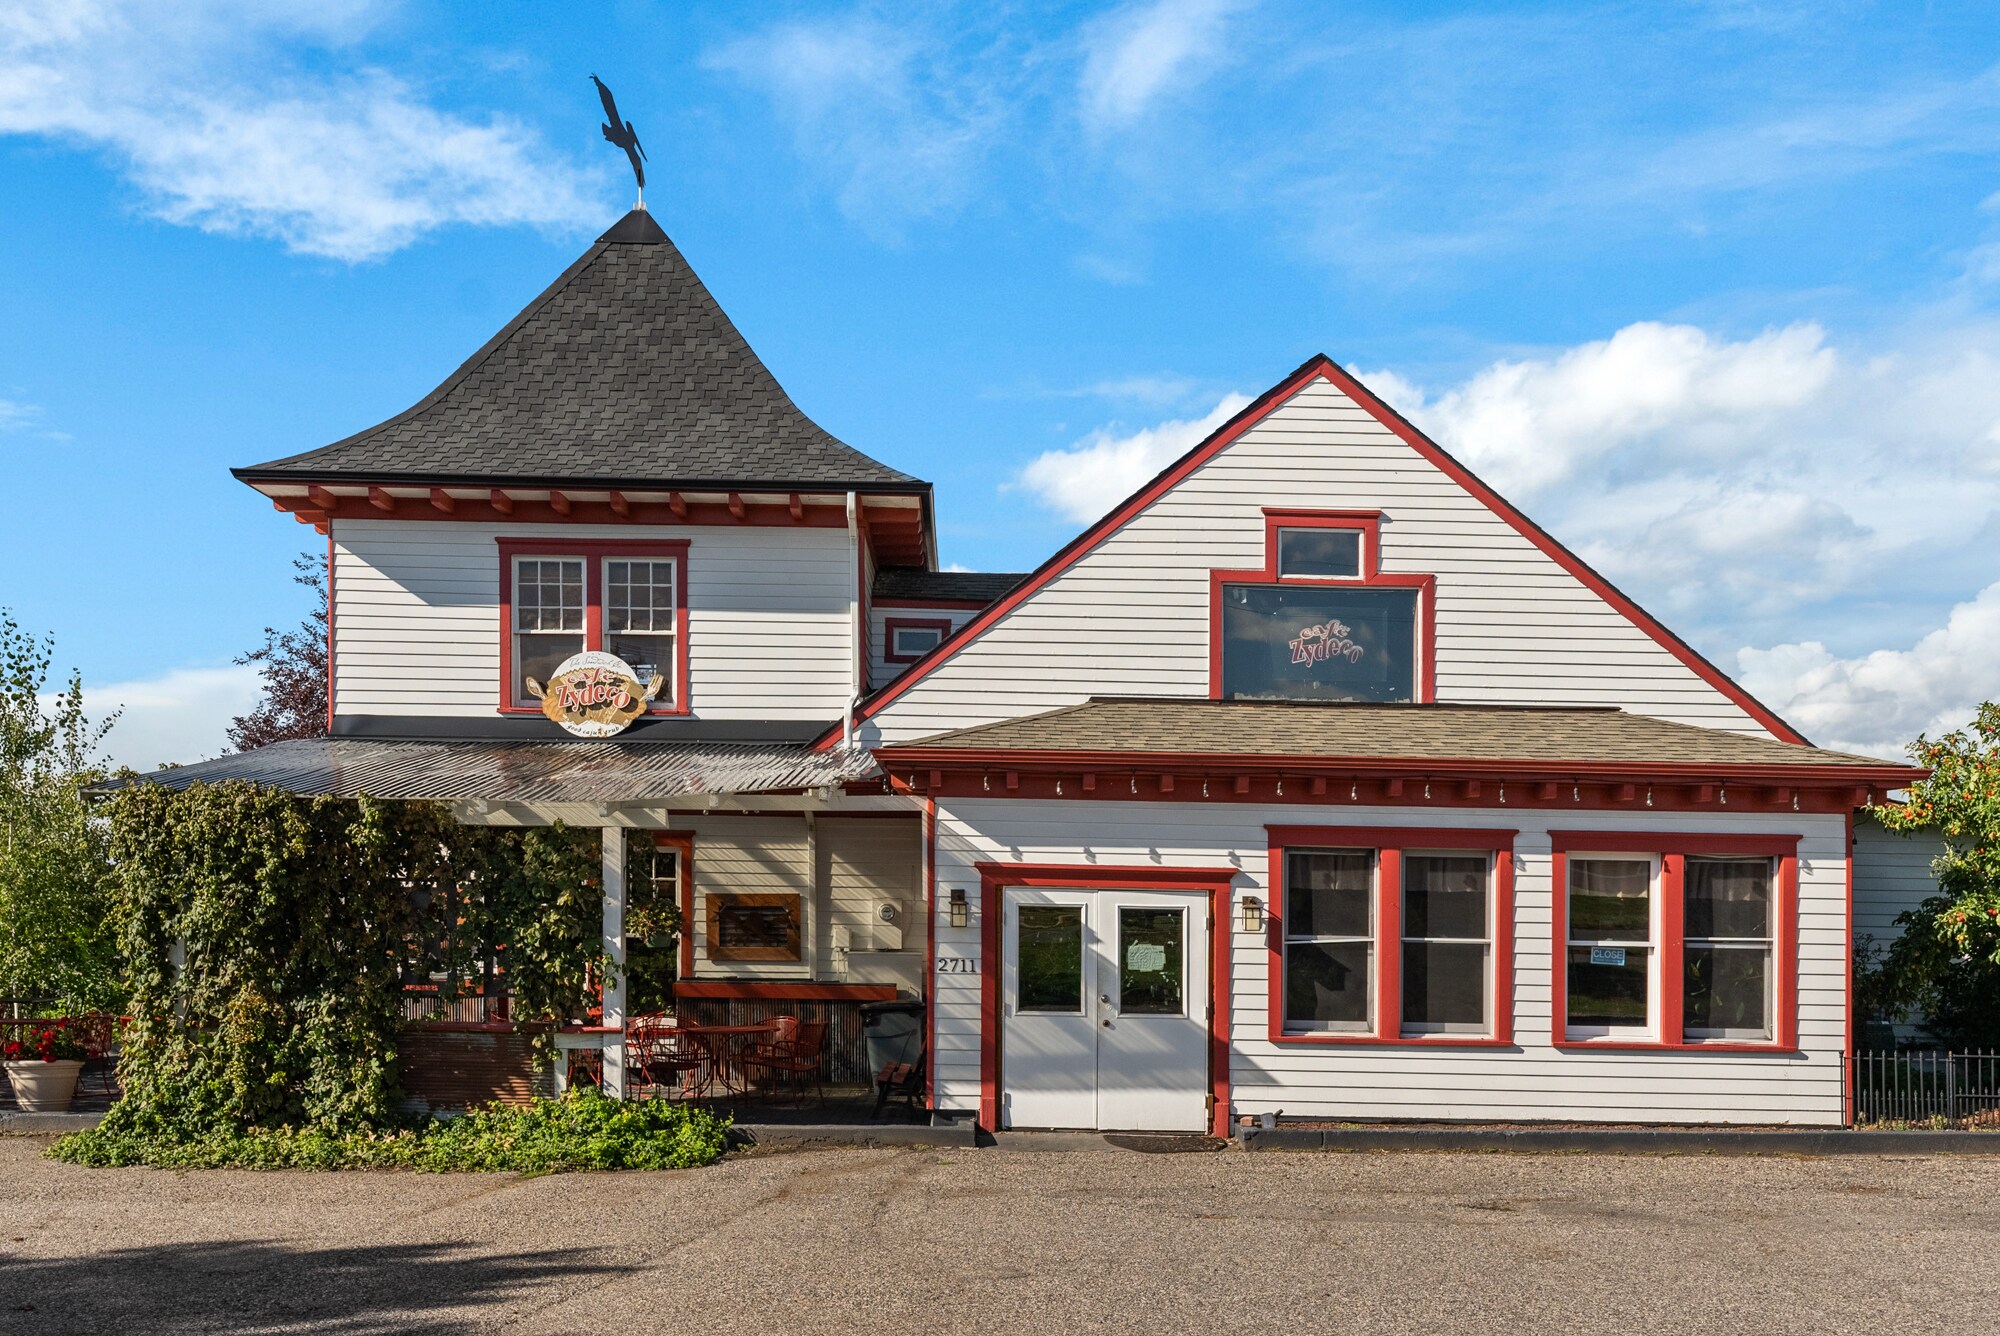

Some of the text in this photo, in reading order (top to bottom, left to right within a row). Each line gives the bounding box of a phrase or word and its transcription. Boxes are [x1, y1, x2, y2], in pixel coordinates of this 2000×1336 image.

[1288, 637, 1364, 668] Zydeco
[555, 682, 631, 712] Zydeco
[567, 725, 582, 733] good
[1593, 949, 1623, 960] CLOSE
[938, 958, 976, 973] 2711
